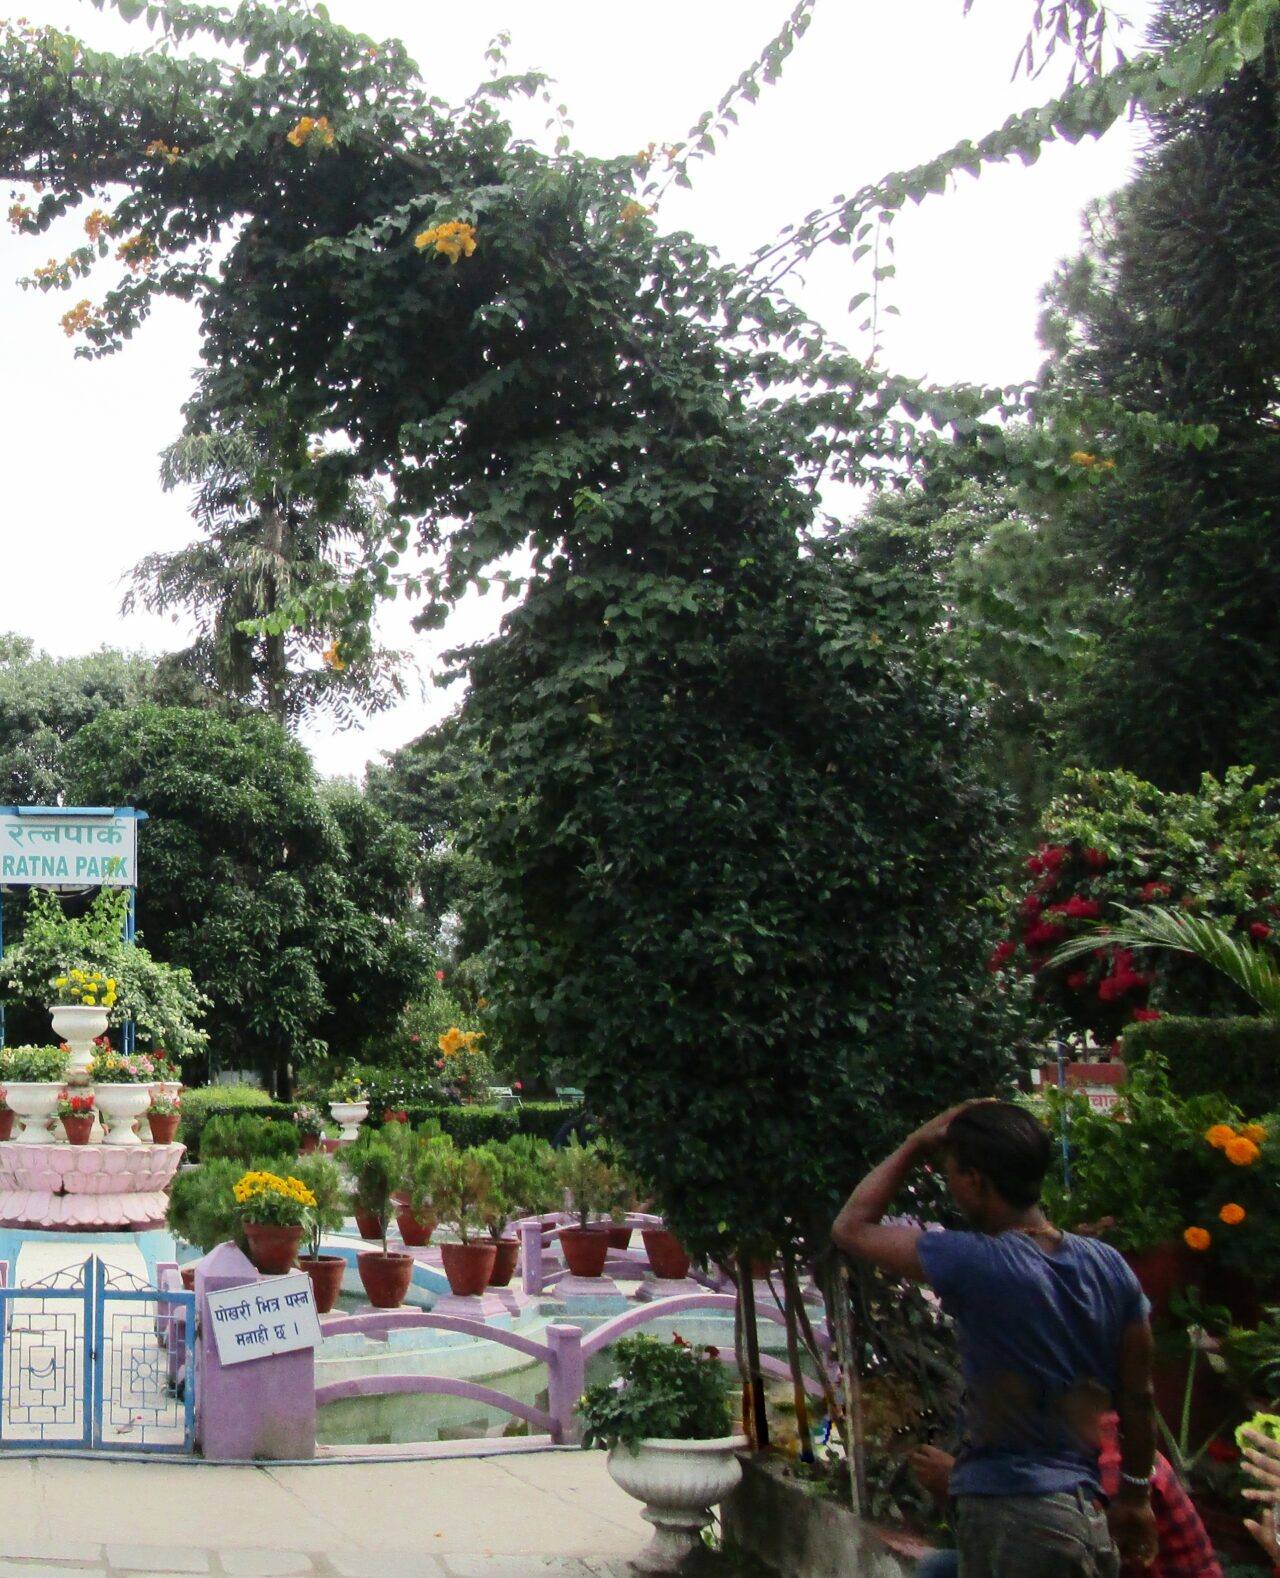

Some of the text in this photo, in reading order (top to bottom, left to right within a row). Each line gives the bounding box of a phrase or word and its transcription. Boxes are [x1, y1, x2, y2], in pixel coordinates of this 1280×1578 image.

[5, 819, 126, 847] रत्नपार्क
[2, 855, 128, 878] RATNA PARK
[214, 1291, 309, 1322] पोखरी भित्र पस्न
[235, 1324, 269, 1346] मनाही
